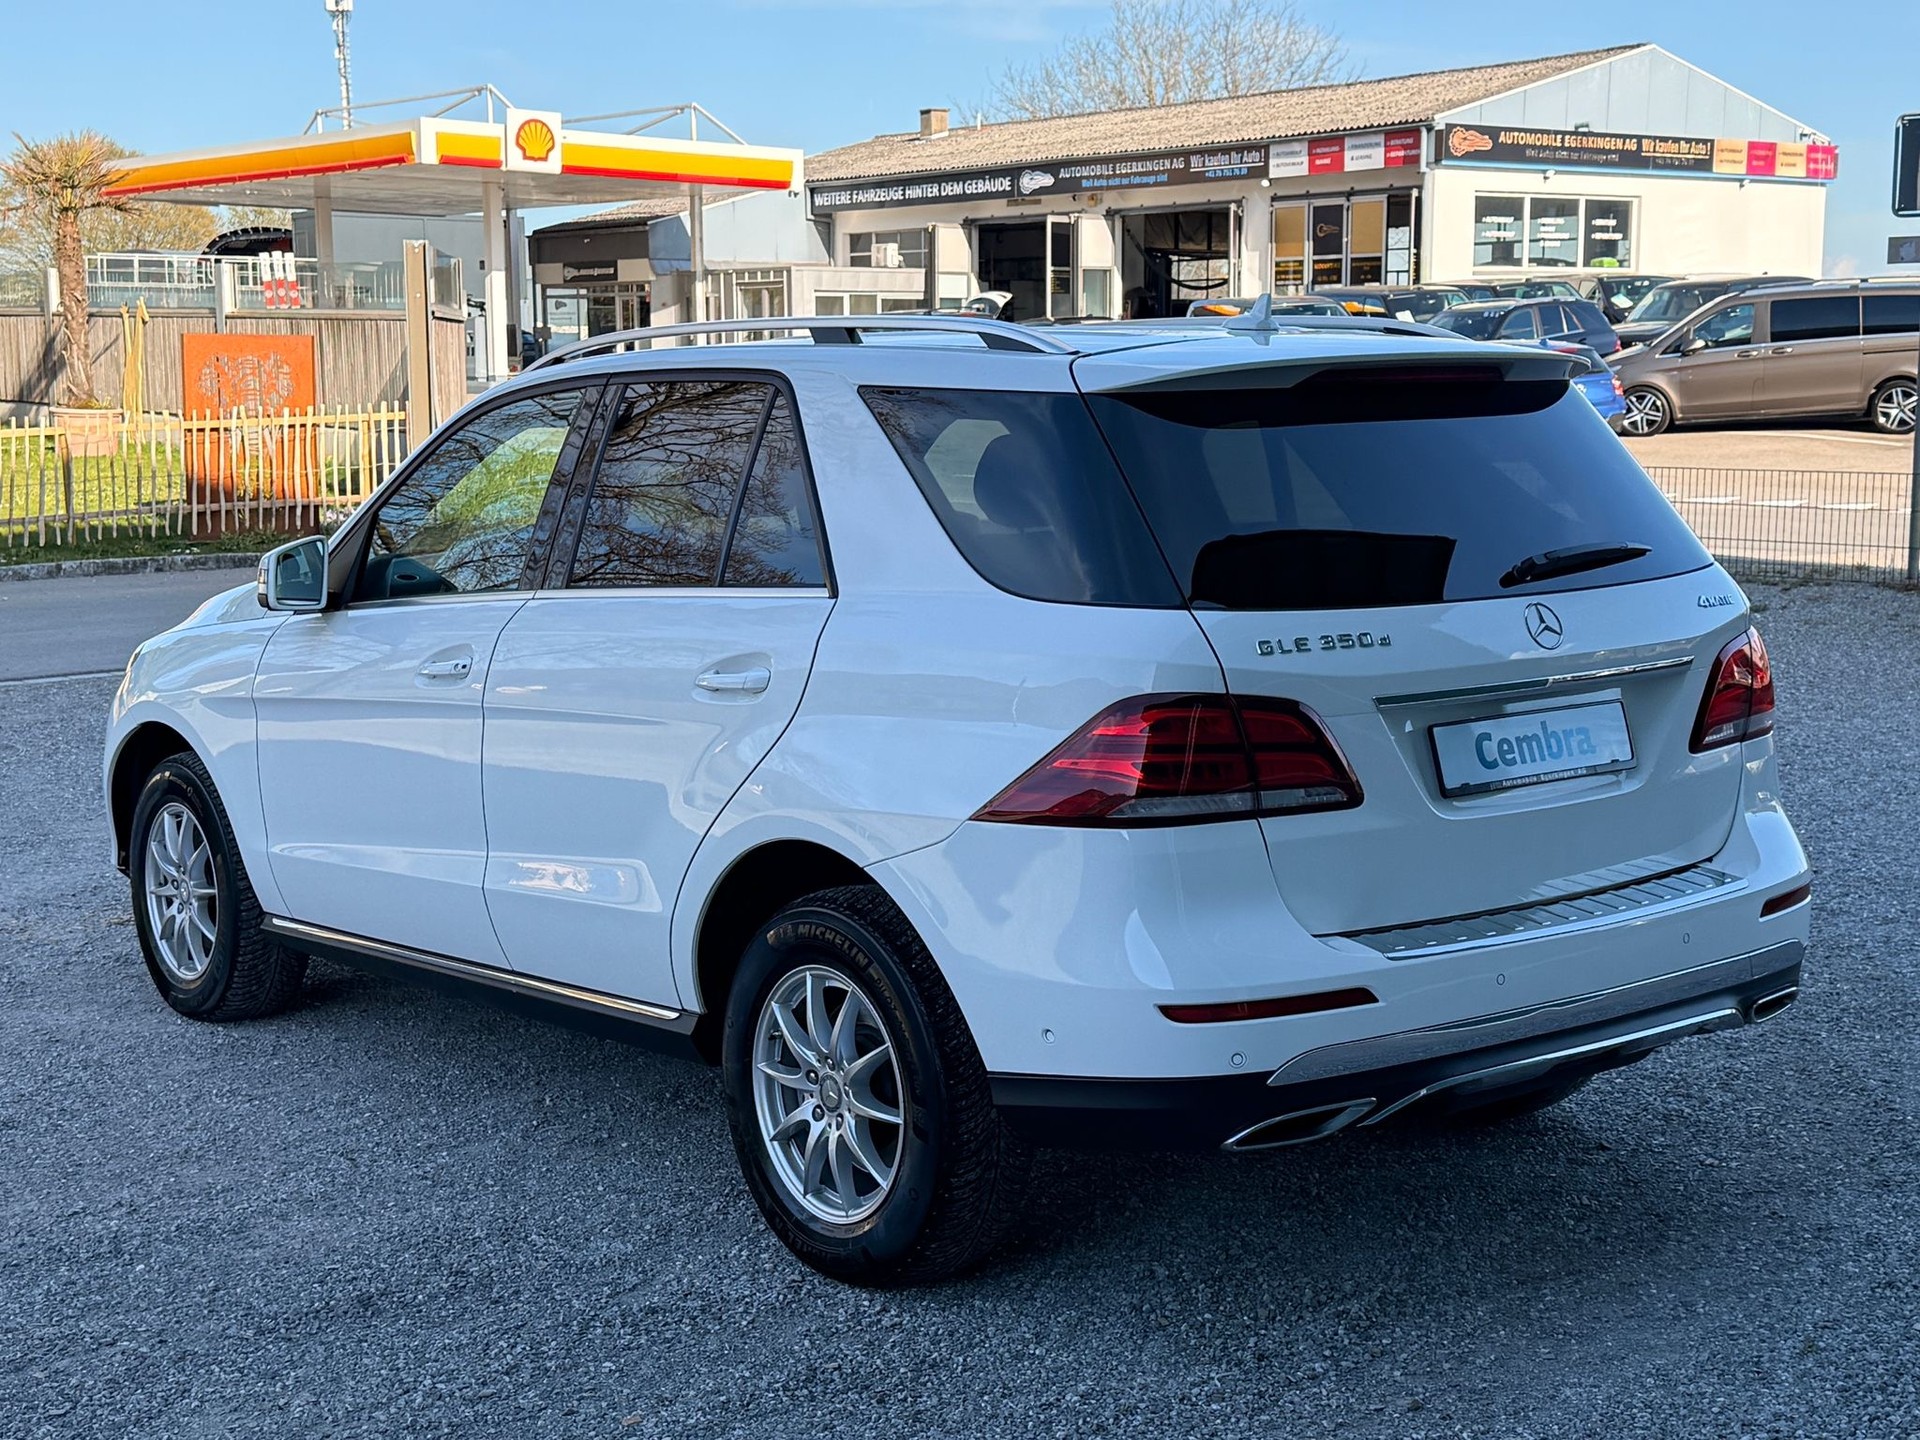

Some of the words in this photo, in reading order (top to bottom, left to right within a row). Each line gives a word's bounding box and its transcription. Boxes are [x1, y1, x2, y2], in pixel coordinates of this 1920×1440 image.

[1498, 131, 1562, 147] AUTOMOBILE
[1564, 134, 1623, 150] EGERKINGEN
[1624, 138, 1637, 151] AG
[1641, 139, 1655, 152] Wir
[1655, 139, 1679, 153] kaufen
[1059, 163, 1114, 178] AUTOMOBILE
[1115, 159, 1171, 174] EGERKINGEN
[1171, 157, 1185, 169] AG
[1190, 154, 1204, 168] Wir
[1204, 152, 1230, 167] kaufen
[1230, 151, 1241, 164] Ihr
[814, 190, 852, 207] WEITERE
[852, 186, 904, 204] FAHRZEUGE
[905, 183, 939, 199] HINTER
[940, 181, 964, 196] DEM
[964, 175, 1012, 194] GEBÄUDE
[1256, 637, 1312, 656] GLE
[1474, 720, 1597, 770] Cembra
[797, 924, 869, 968] MICHELIN
